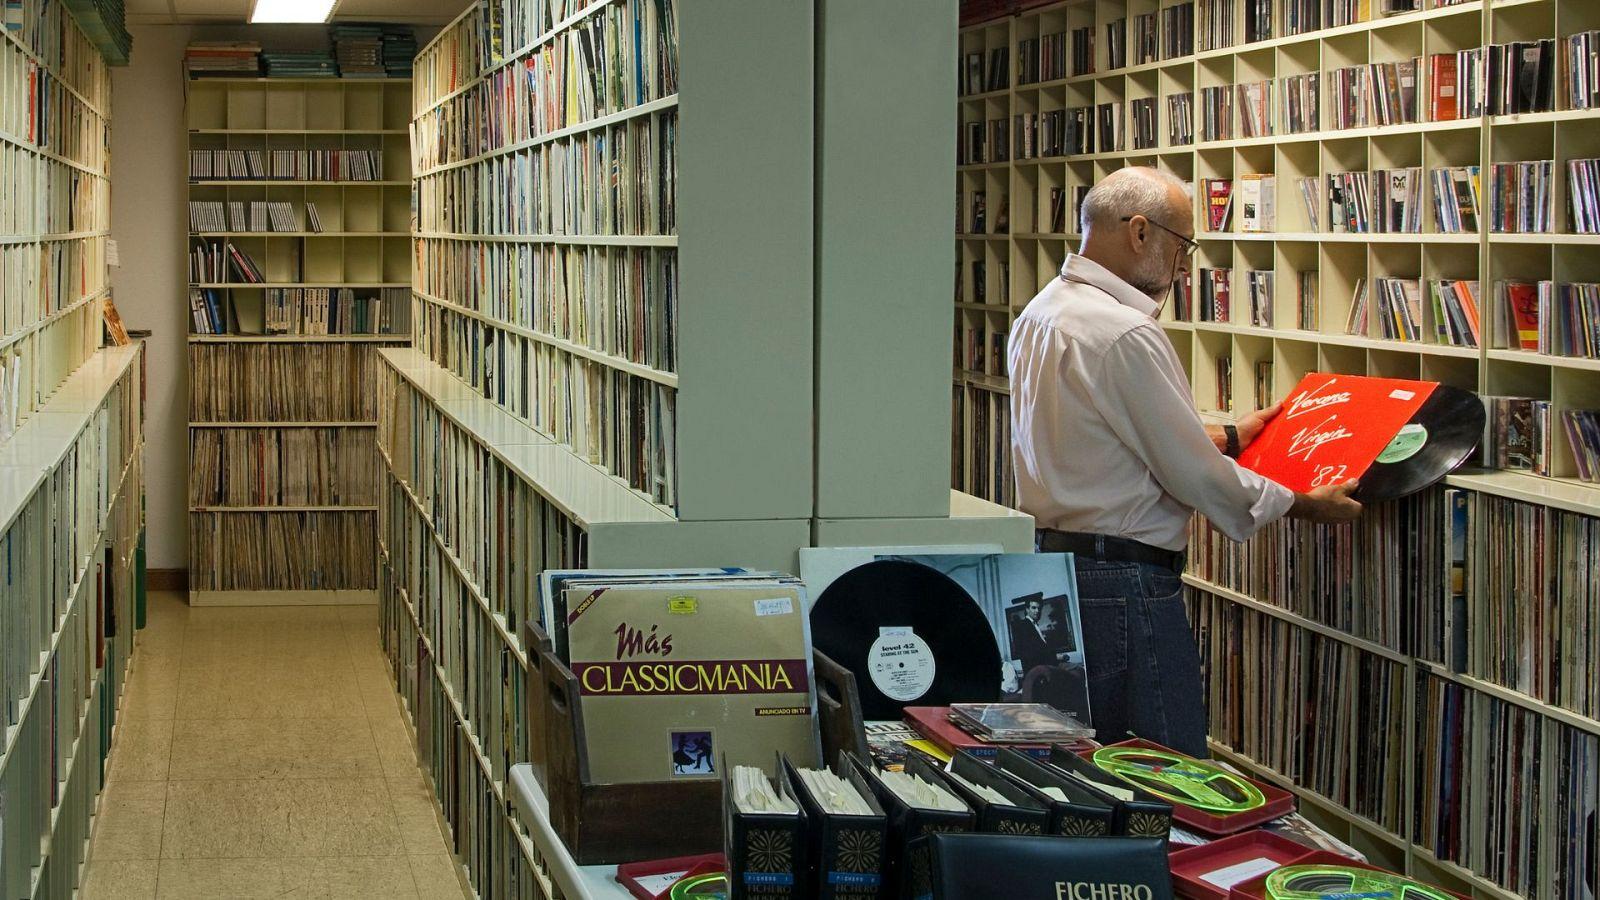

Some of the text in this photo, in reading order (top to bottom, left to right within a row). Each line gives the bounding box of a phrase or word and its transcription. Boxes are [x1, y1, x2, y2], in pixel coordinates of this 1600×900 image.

[1288, 414, 1352, 461] Virgin
[614, 622, 673, 660] Más
[881, 644, 902, 652] level
[582, 663, 793, 692] CLASSICMANIA
[1055, 881, 1153, 900] FICHERO
